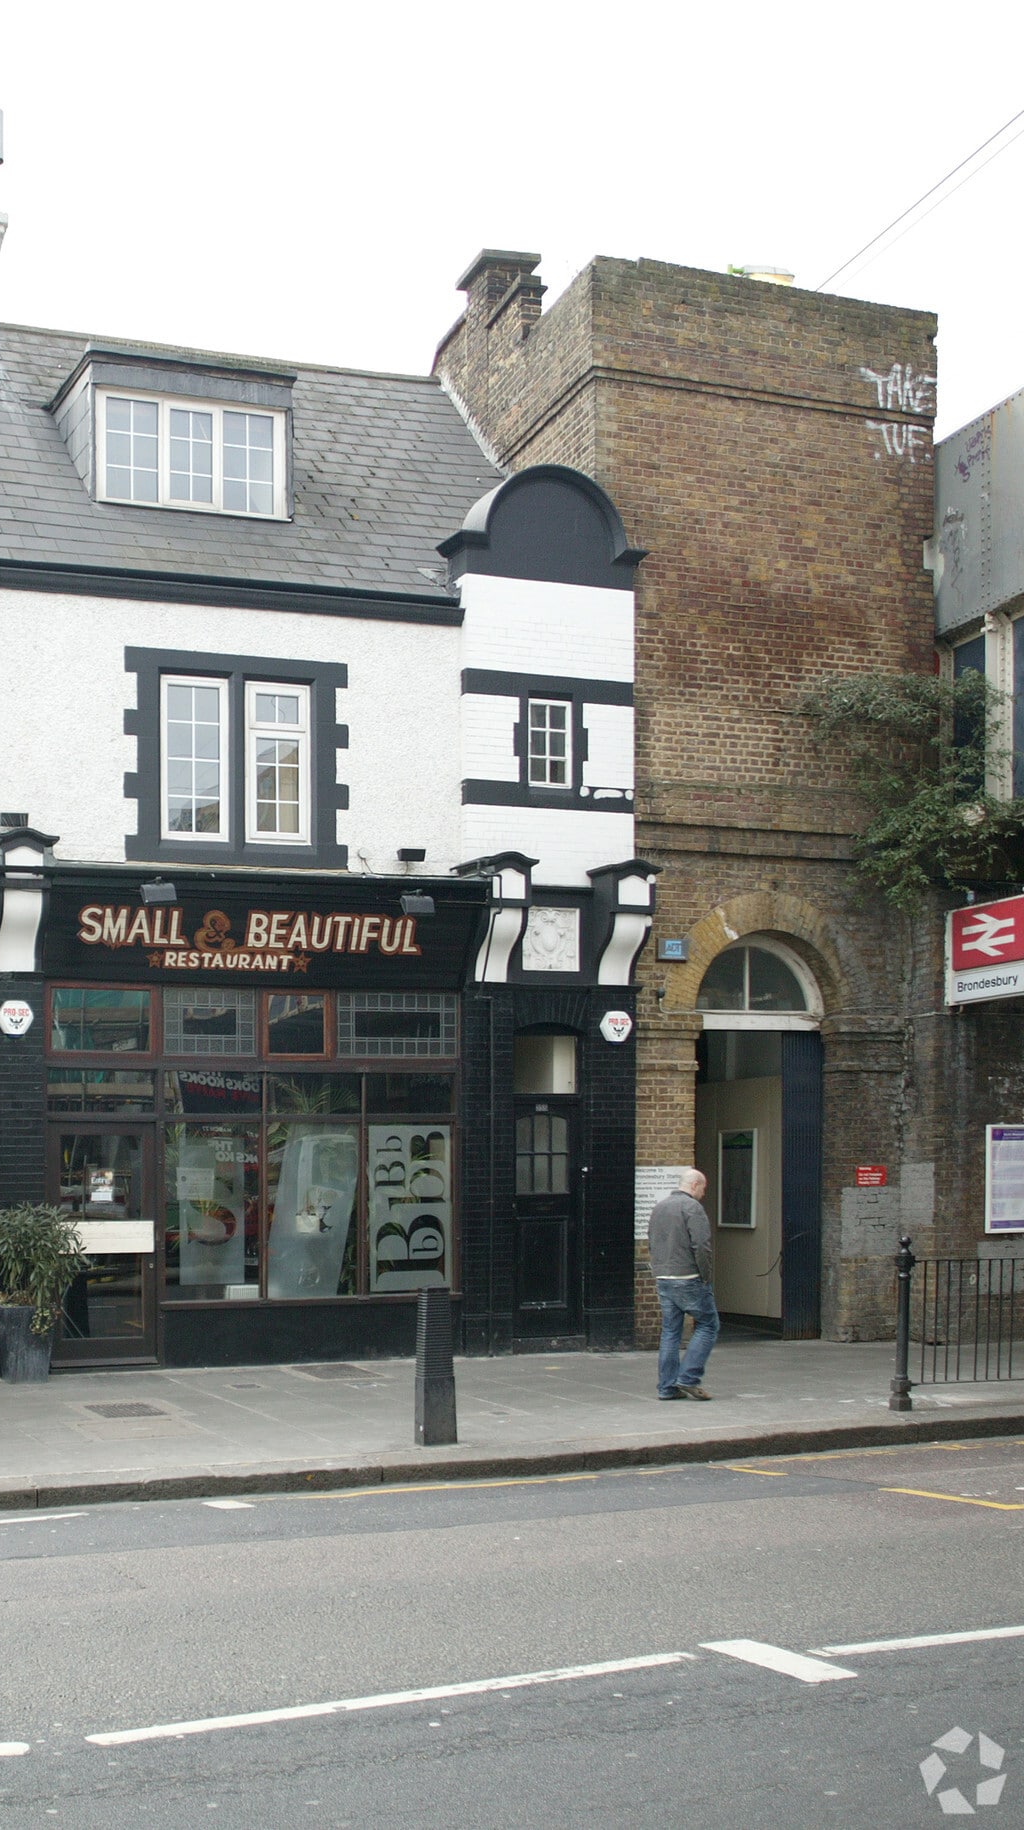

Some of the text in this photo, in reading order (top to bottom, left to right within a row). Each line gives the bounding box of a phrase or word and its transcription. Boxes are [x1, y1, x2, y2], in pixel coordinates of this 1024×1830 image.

[79, 906, 186, 945] SMALL
[247, 912, 419, 954] BEAUTIFUL
[164, 952, 294, 971] RESTAURANT
[957, 975, 1018, 992] Brondesbury
[3, 1008, 29, 1016] PRO-SEC
